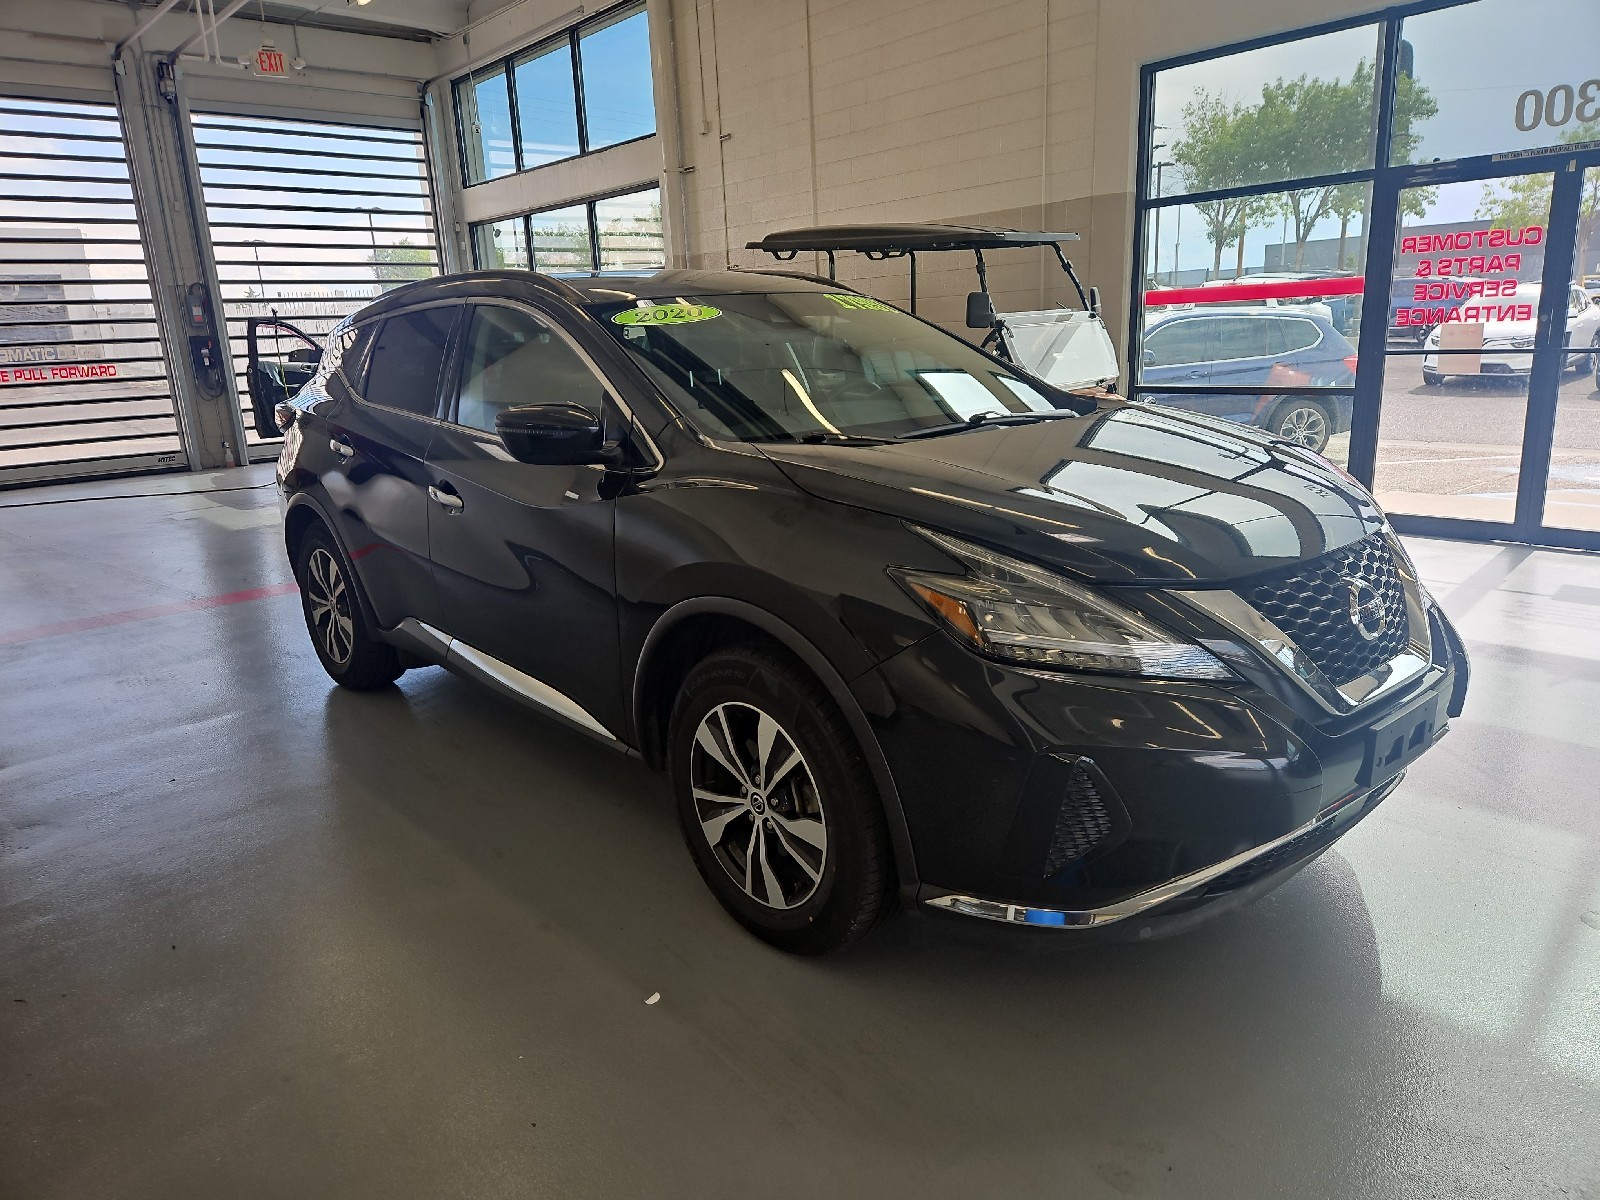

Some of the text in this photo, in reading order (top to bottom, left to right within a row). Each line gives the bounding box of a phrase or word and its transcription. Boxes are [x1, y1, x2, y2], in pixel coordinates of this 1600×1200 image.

[258, 52, 284, 72] EXIT
[635, 307, 702, 323] 2020
[13, 368, 47, 381] PULL
[51, 365, 117, 379] FORWARD
